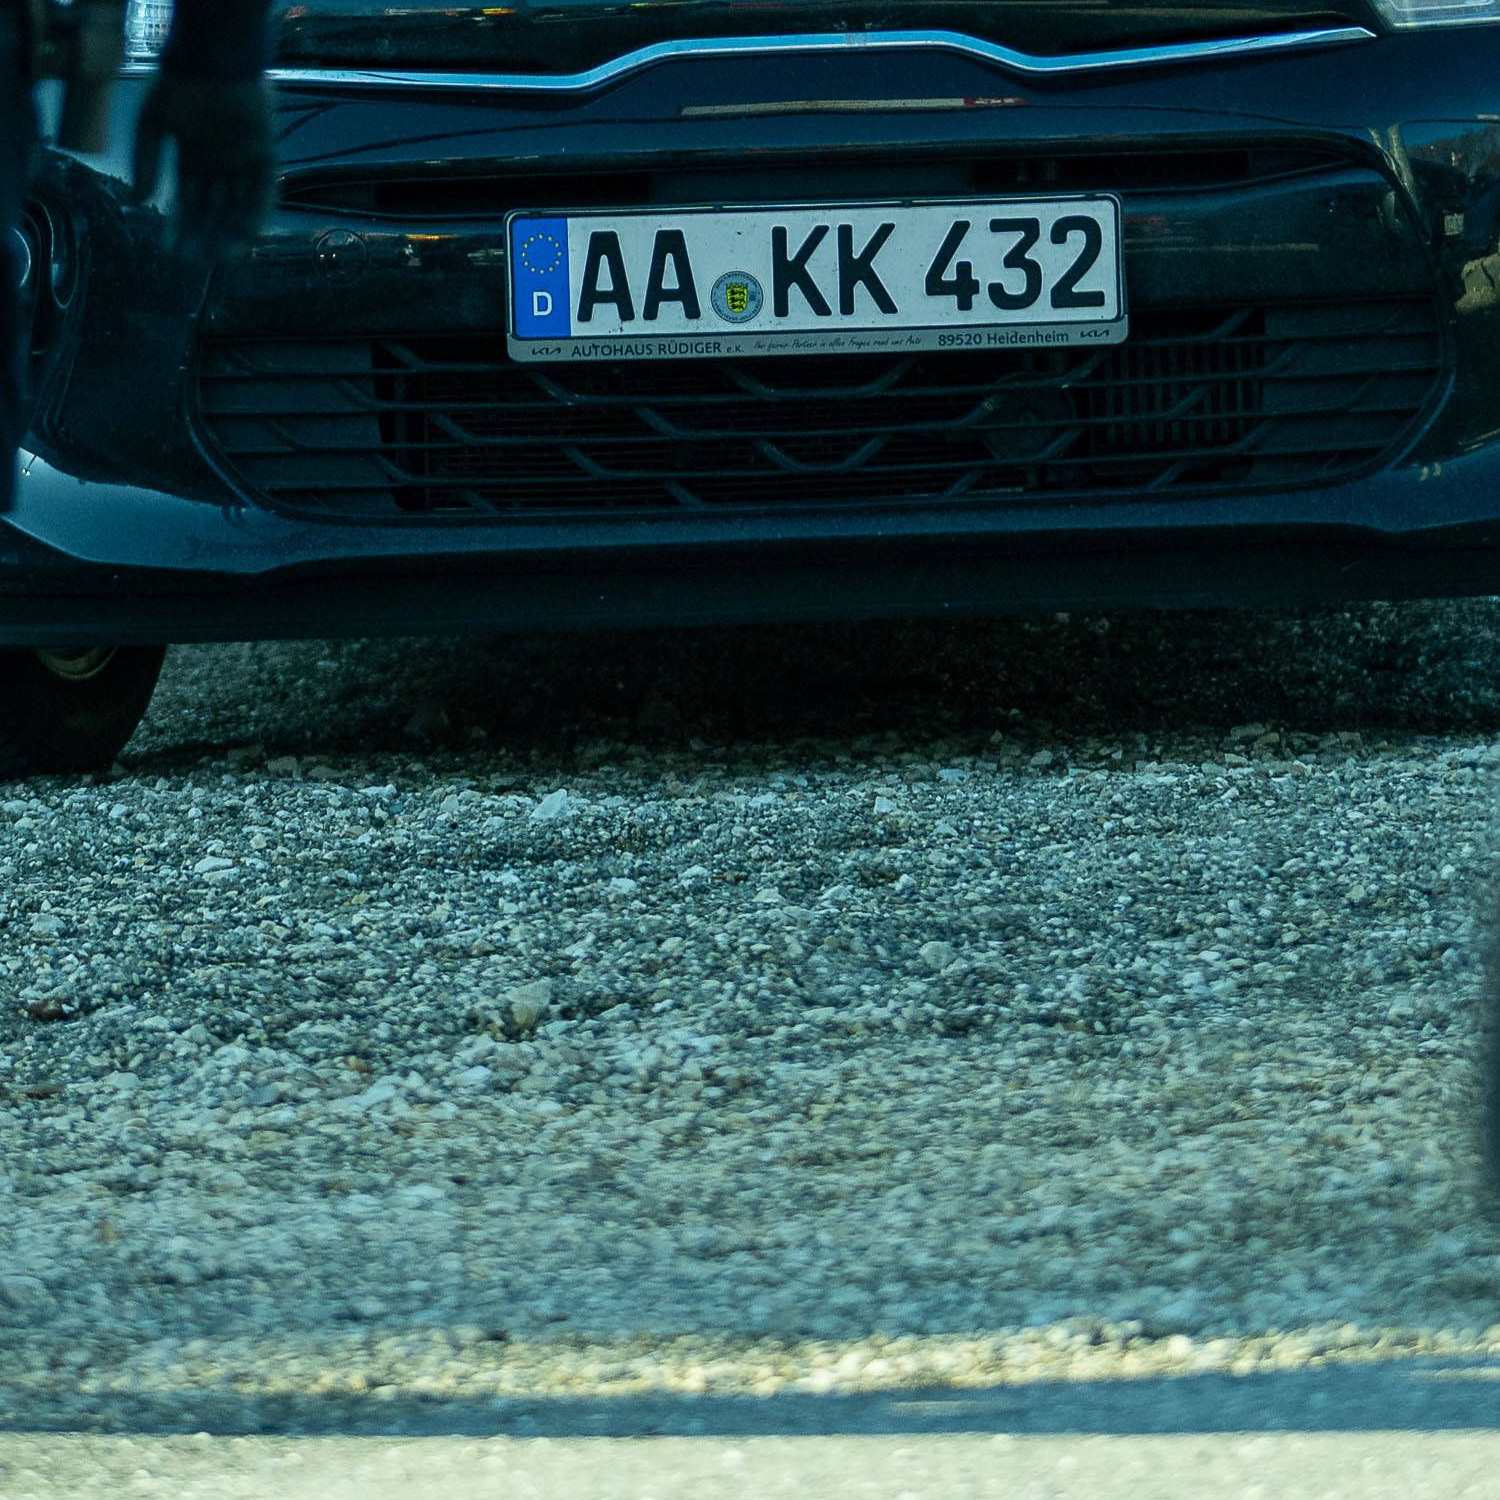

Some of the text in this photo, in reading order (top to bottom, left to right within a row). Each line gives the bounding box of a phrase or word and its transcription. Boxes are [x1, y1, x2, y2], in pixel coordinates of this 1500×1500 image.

[576, 229, 702, 323] AA
[771, 222, 899, 318] KK
[925, 215, 1106, 311] 432
[532, 291, 553, 317] D
[571, 342, 654, 357] AUTOHAUS
[658, 339, 722, 355] RÜDIGER
[938, 330, 1069, 346] 89520 Heidenheim
